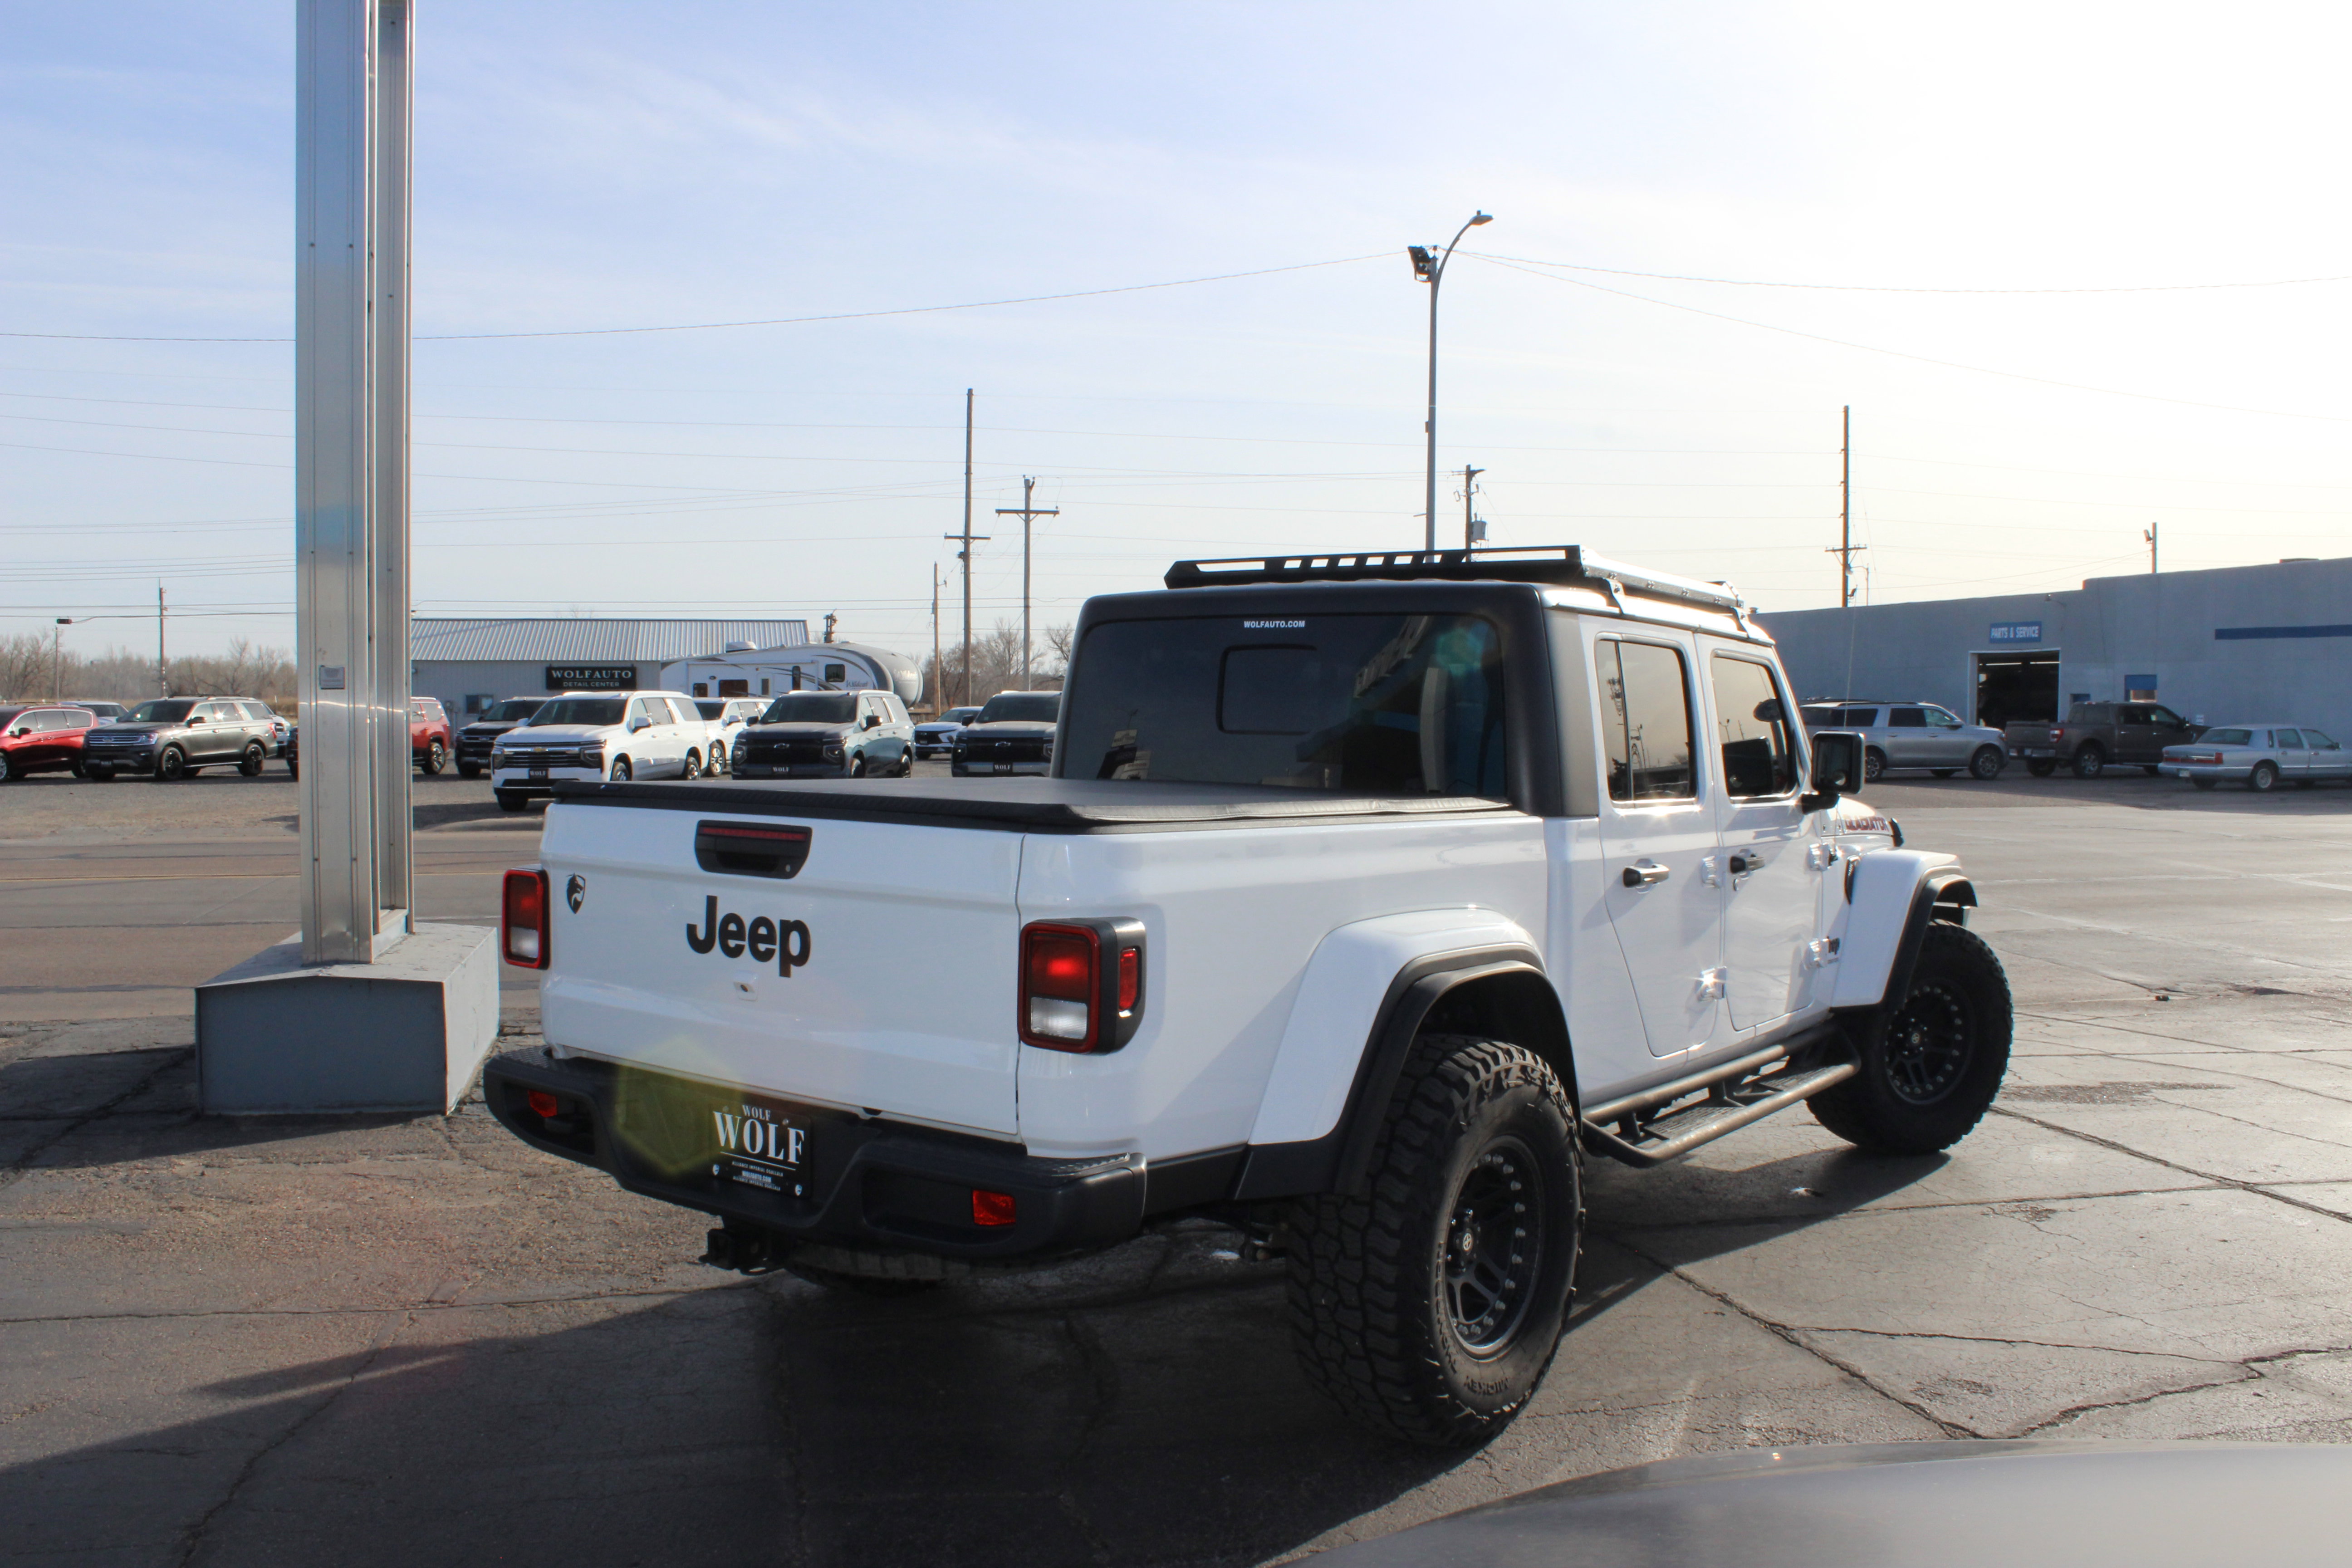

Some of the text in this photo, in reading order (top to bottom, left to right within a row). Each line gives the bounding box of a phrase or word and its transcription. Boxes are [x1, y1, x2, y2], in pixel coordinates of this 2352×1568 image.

[1991, 627, 2008, 638] PARTS
[2016, 626, 2039, 638] SERVICE
[552, 670, 632, 678] WOLFAUTO
[686, 895, 811, 978] Jeep
[742, 1104, 771, 1121] WOLF
[713, 1111, 804, 1164] WOLF
